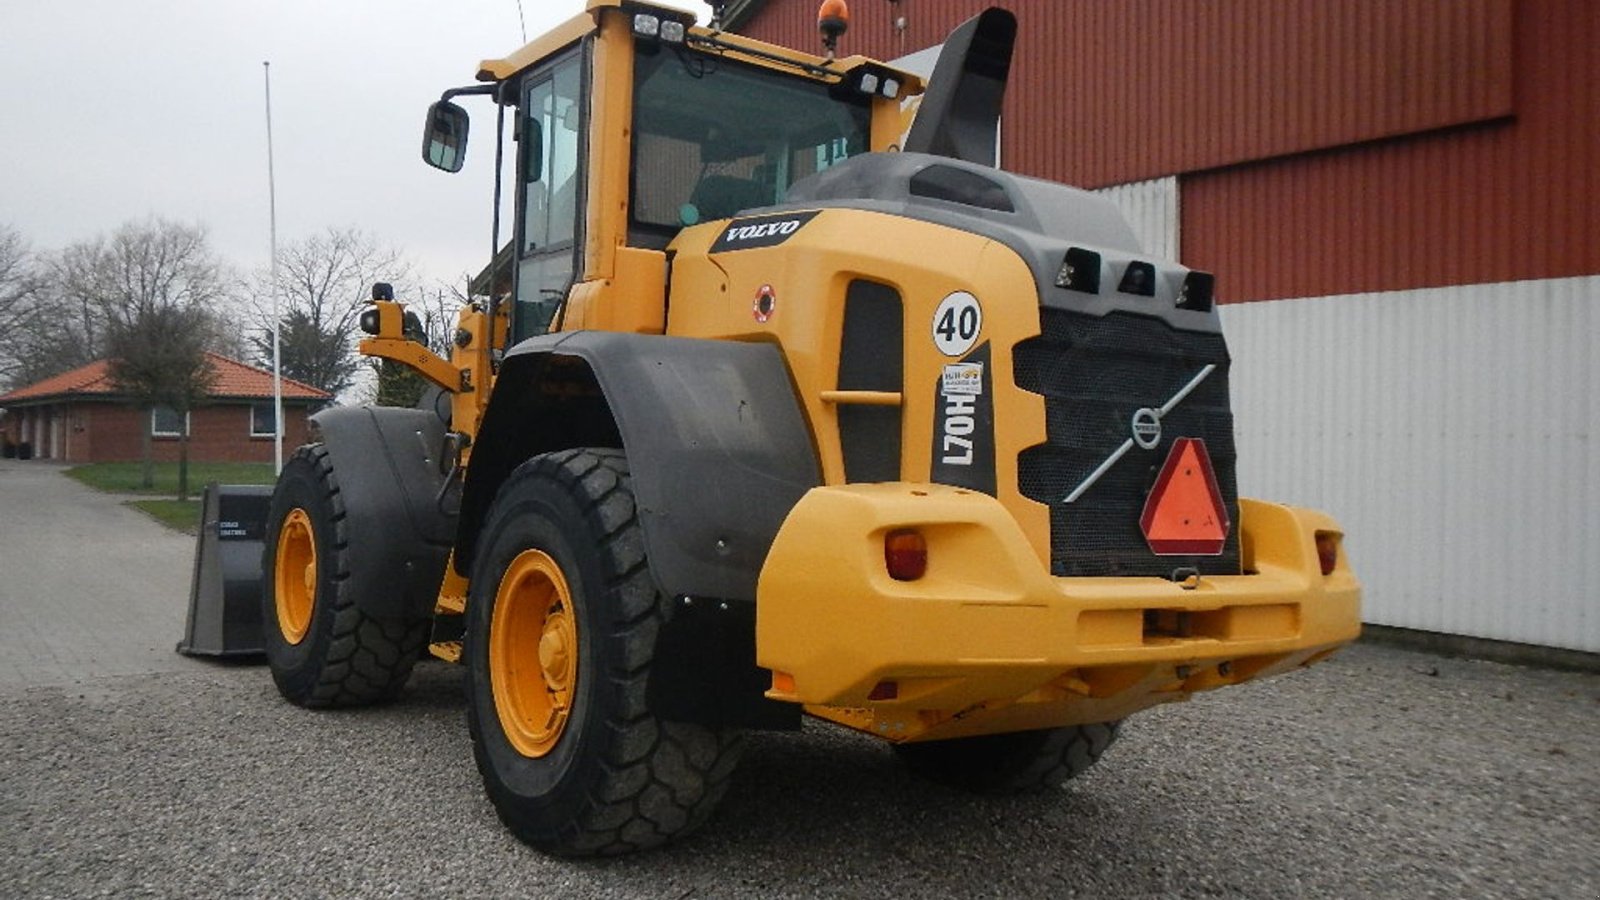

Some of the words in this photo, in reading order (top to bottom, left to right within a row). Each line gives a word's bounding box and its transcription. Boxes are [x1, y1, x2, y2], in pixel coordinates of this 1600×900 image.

[726, 220, 800, 242] VOLVO
[936, 305, 977, 341] 40
[942, 394, 976, 466] L70H
